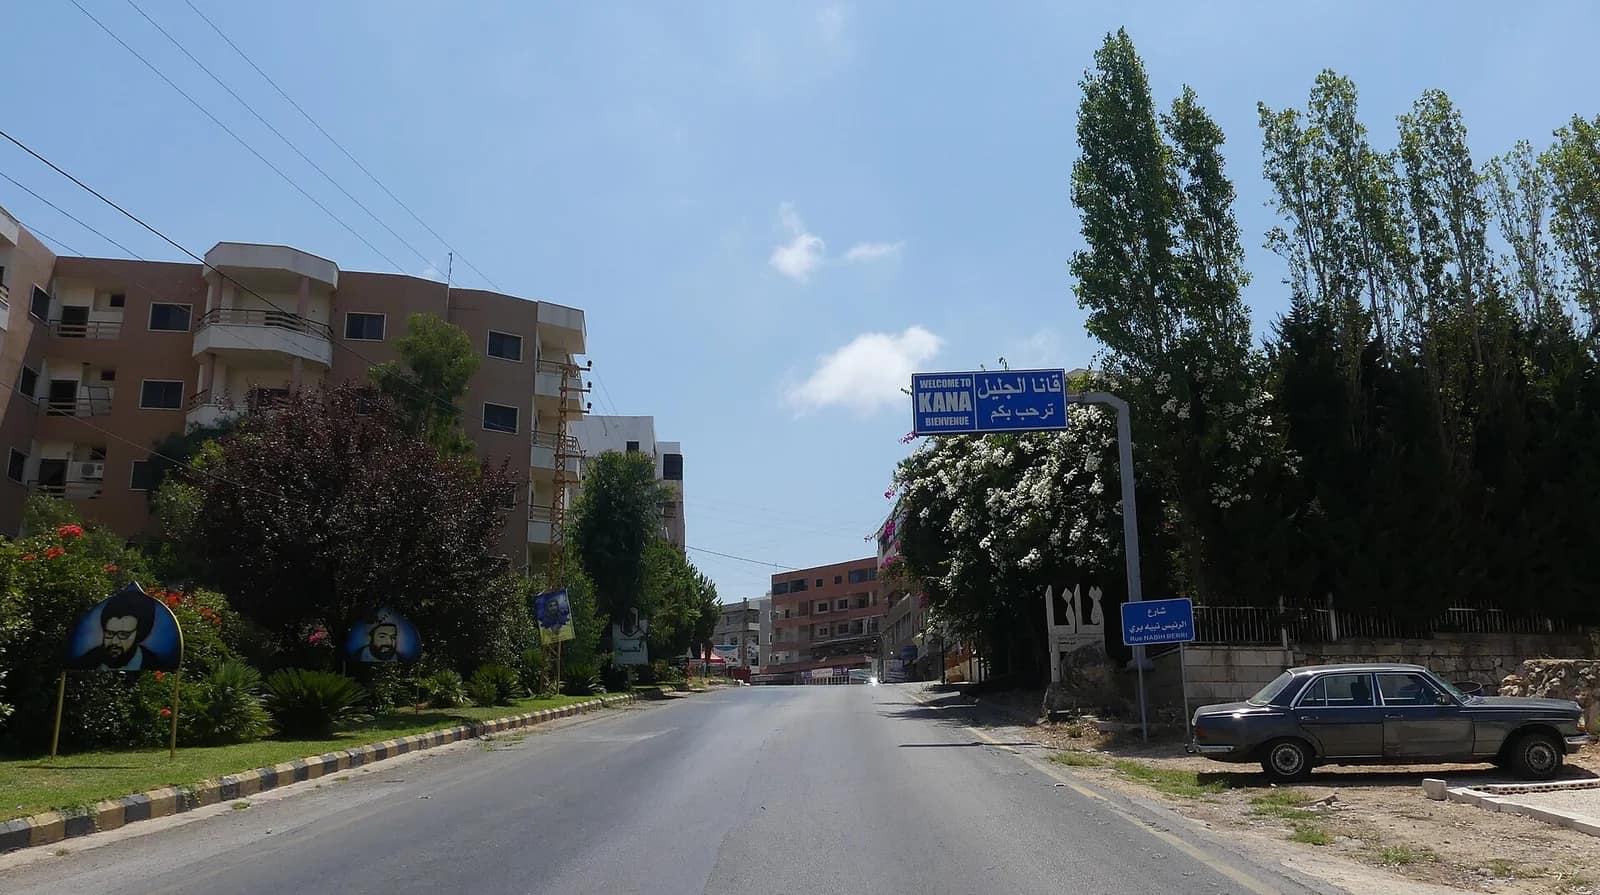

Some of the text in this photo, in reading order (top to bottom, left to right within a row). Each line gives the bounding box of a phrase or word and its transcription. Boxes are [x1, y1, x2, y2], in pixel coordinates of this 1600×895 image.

[919, 378, 971, 389] WELCOME TO
[977, 374, 1061, 400] قانا الجليل
[918, 391, 972, 413] KANA
[990, 405, 1011, 424] بكم
[925, 416, 969, 426] BIENVENUE
[1147, 607, 1167, 618] شارع
[1128, 620, 1187, 634] الرئيس نبيه بري
[1144, 633, 1166, 641] NABIH
